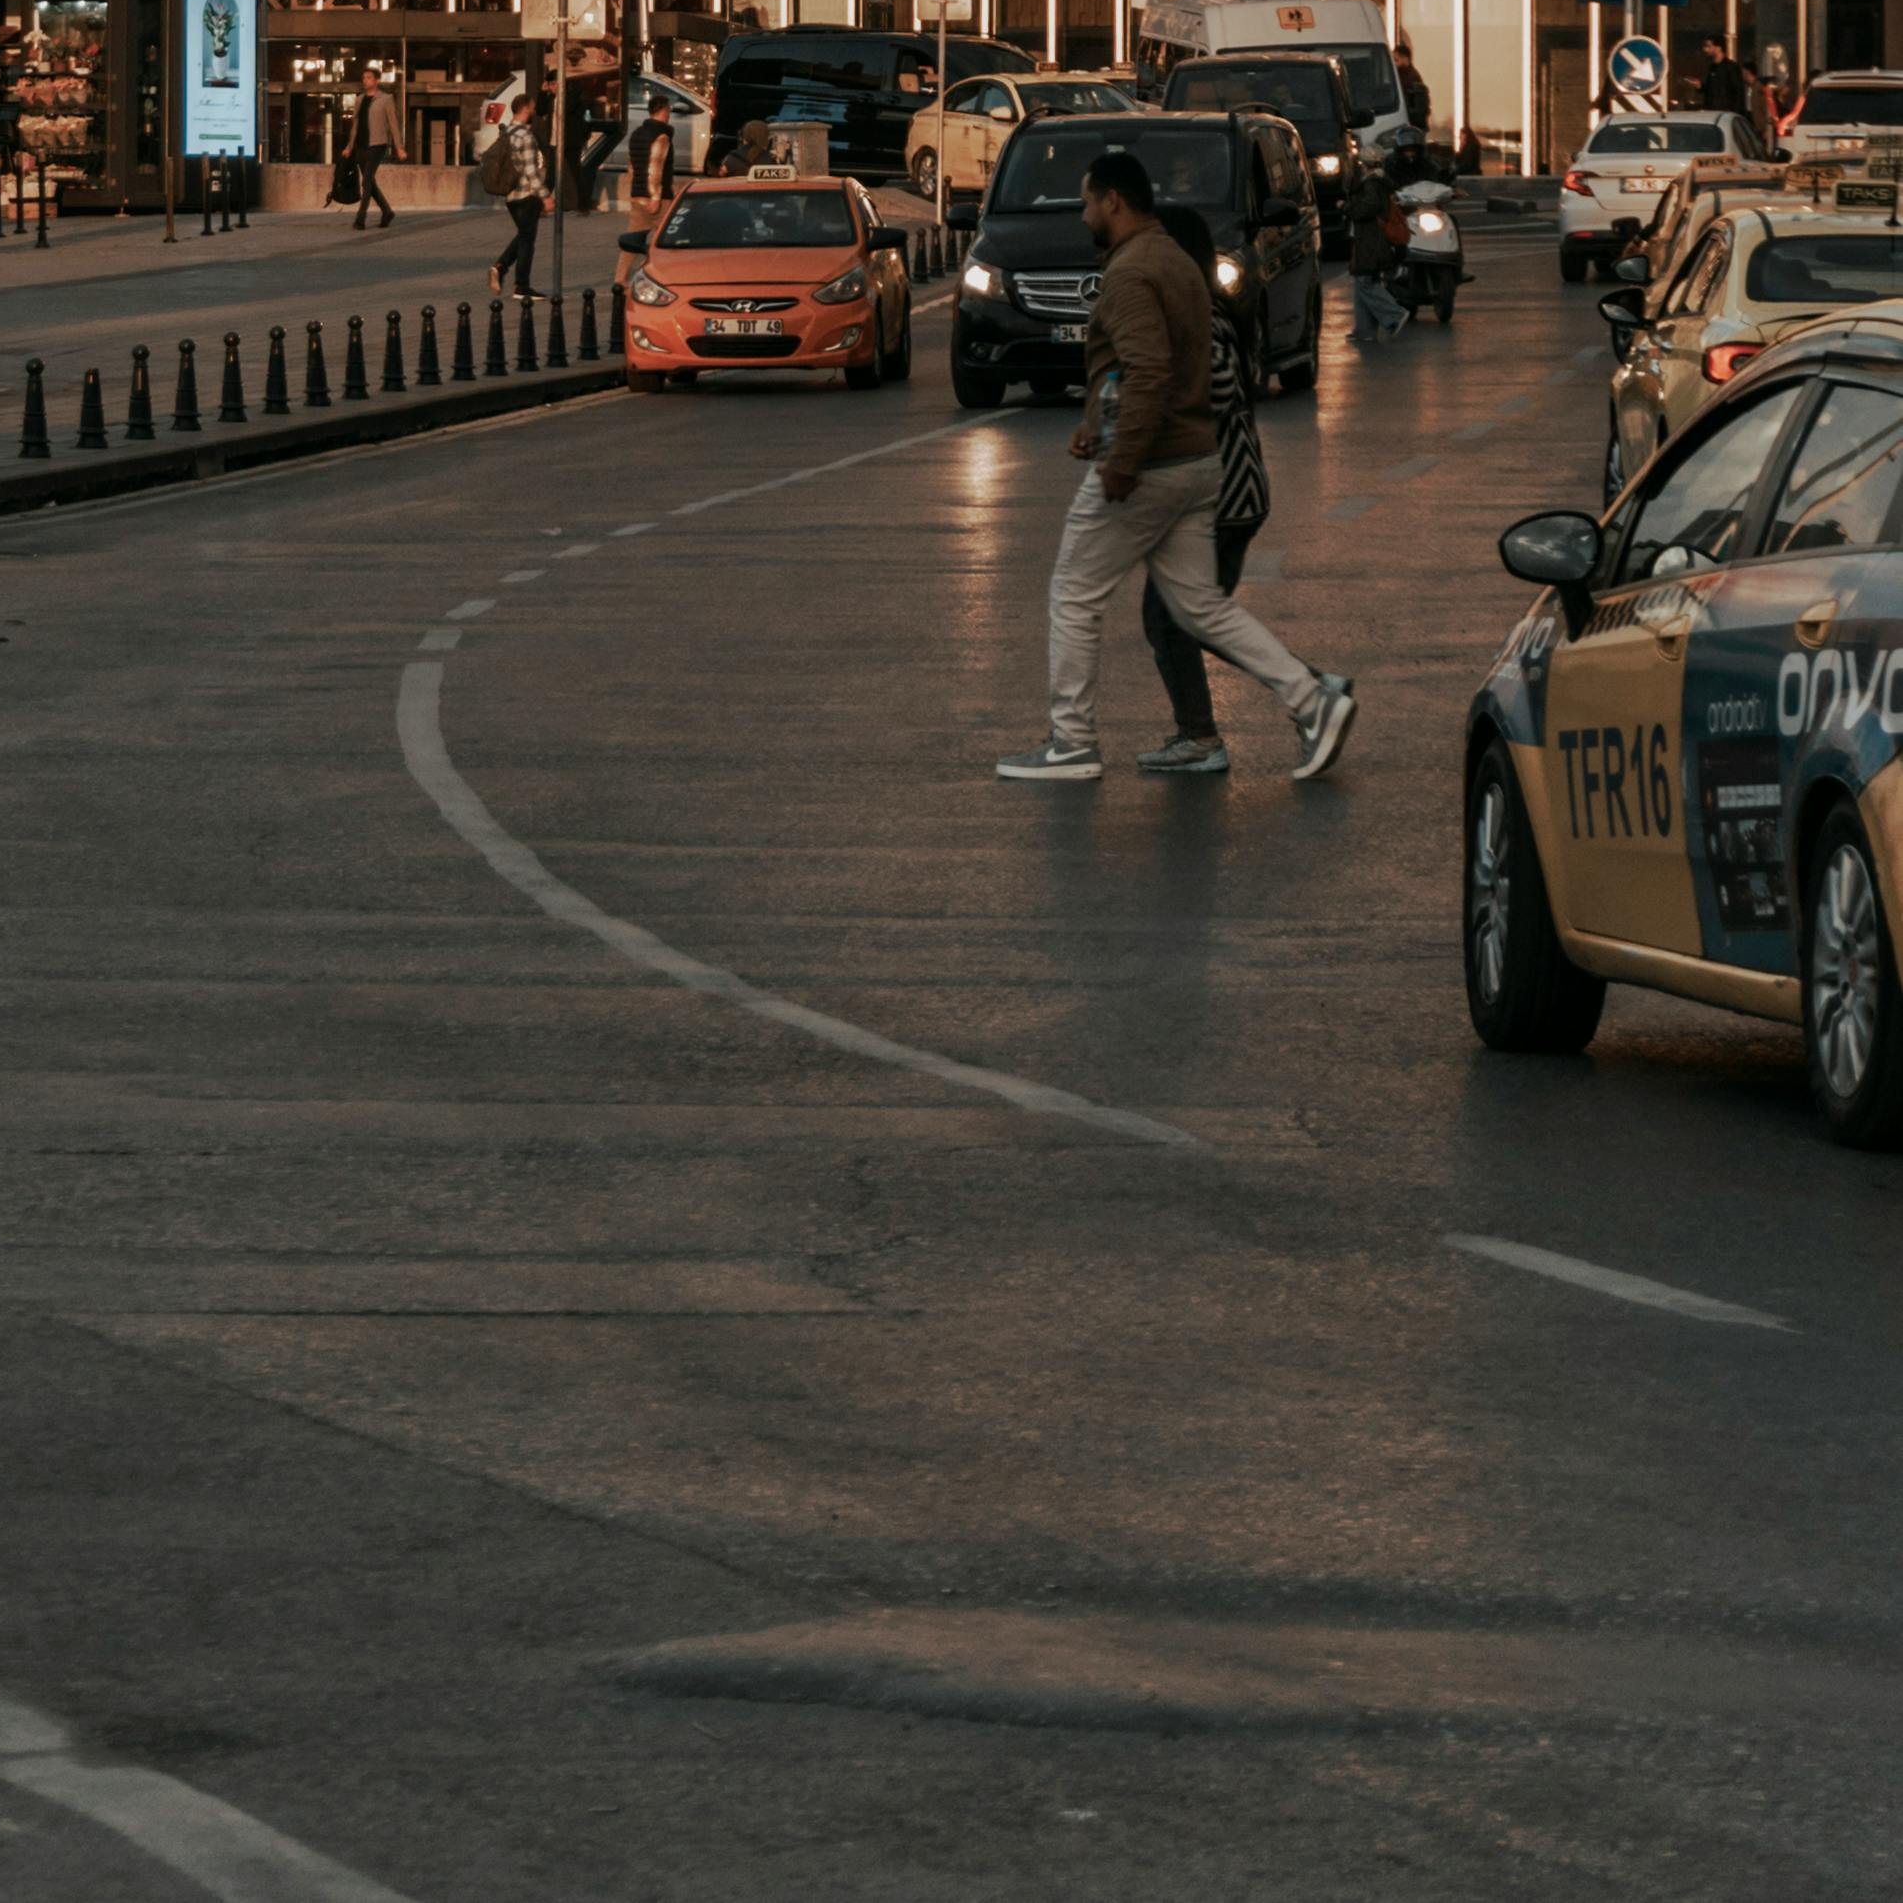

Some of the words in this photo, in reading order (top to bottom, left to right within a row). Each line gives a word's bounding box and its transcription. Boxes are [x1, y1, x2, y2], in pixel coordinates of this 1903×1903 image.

[711, 320, 726, 332] 34
[766, 320, 782, 334] 49
[1061, 326, 1076, 340] 34
[1558, 723, 1672, 839] TFR16
